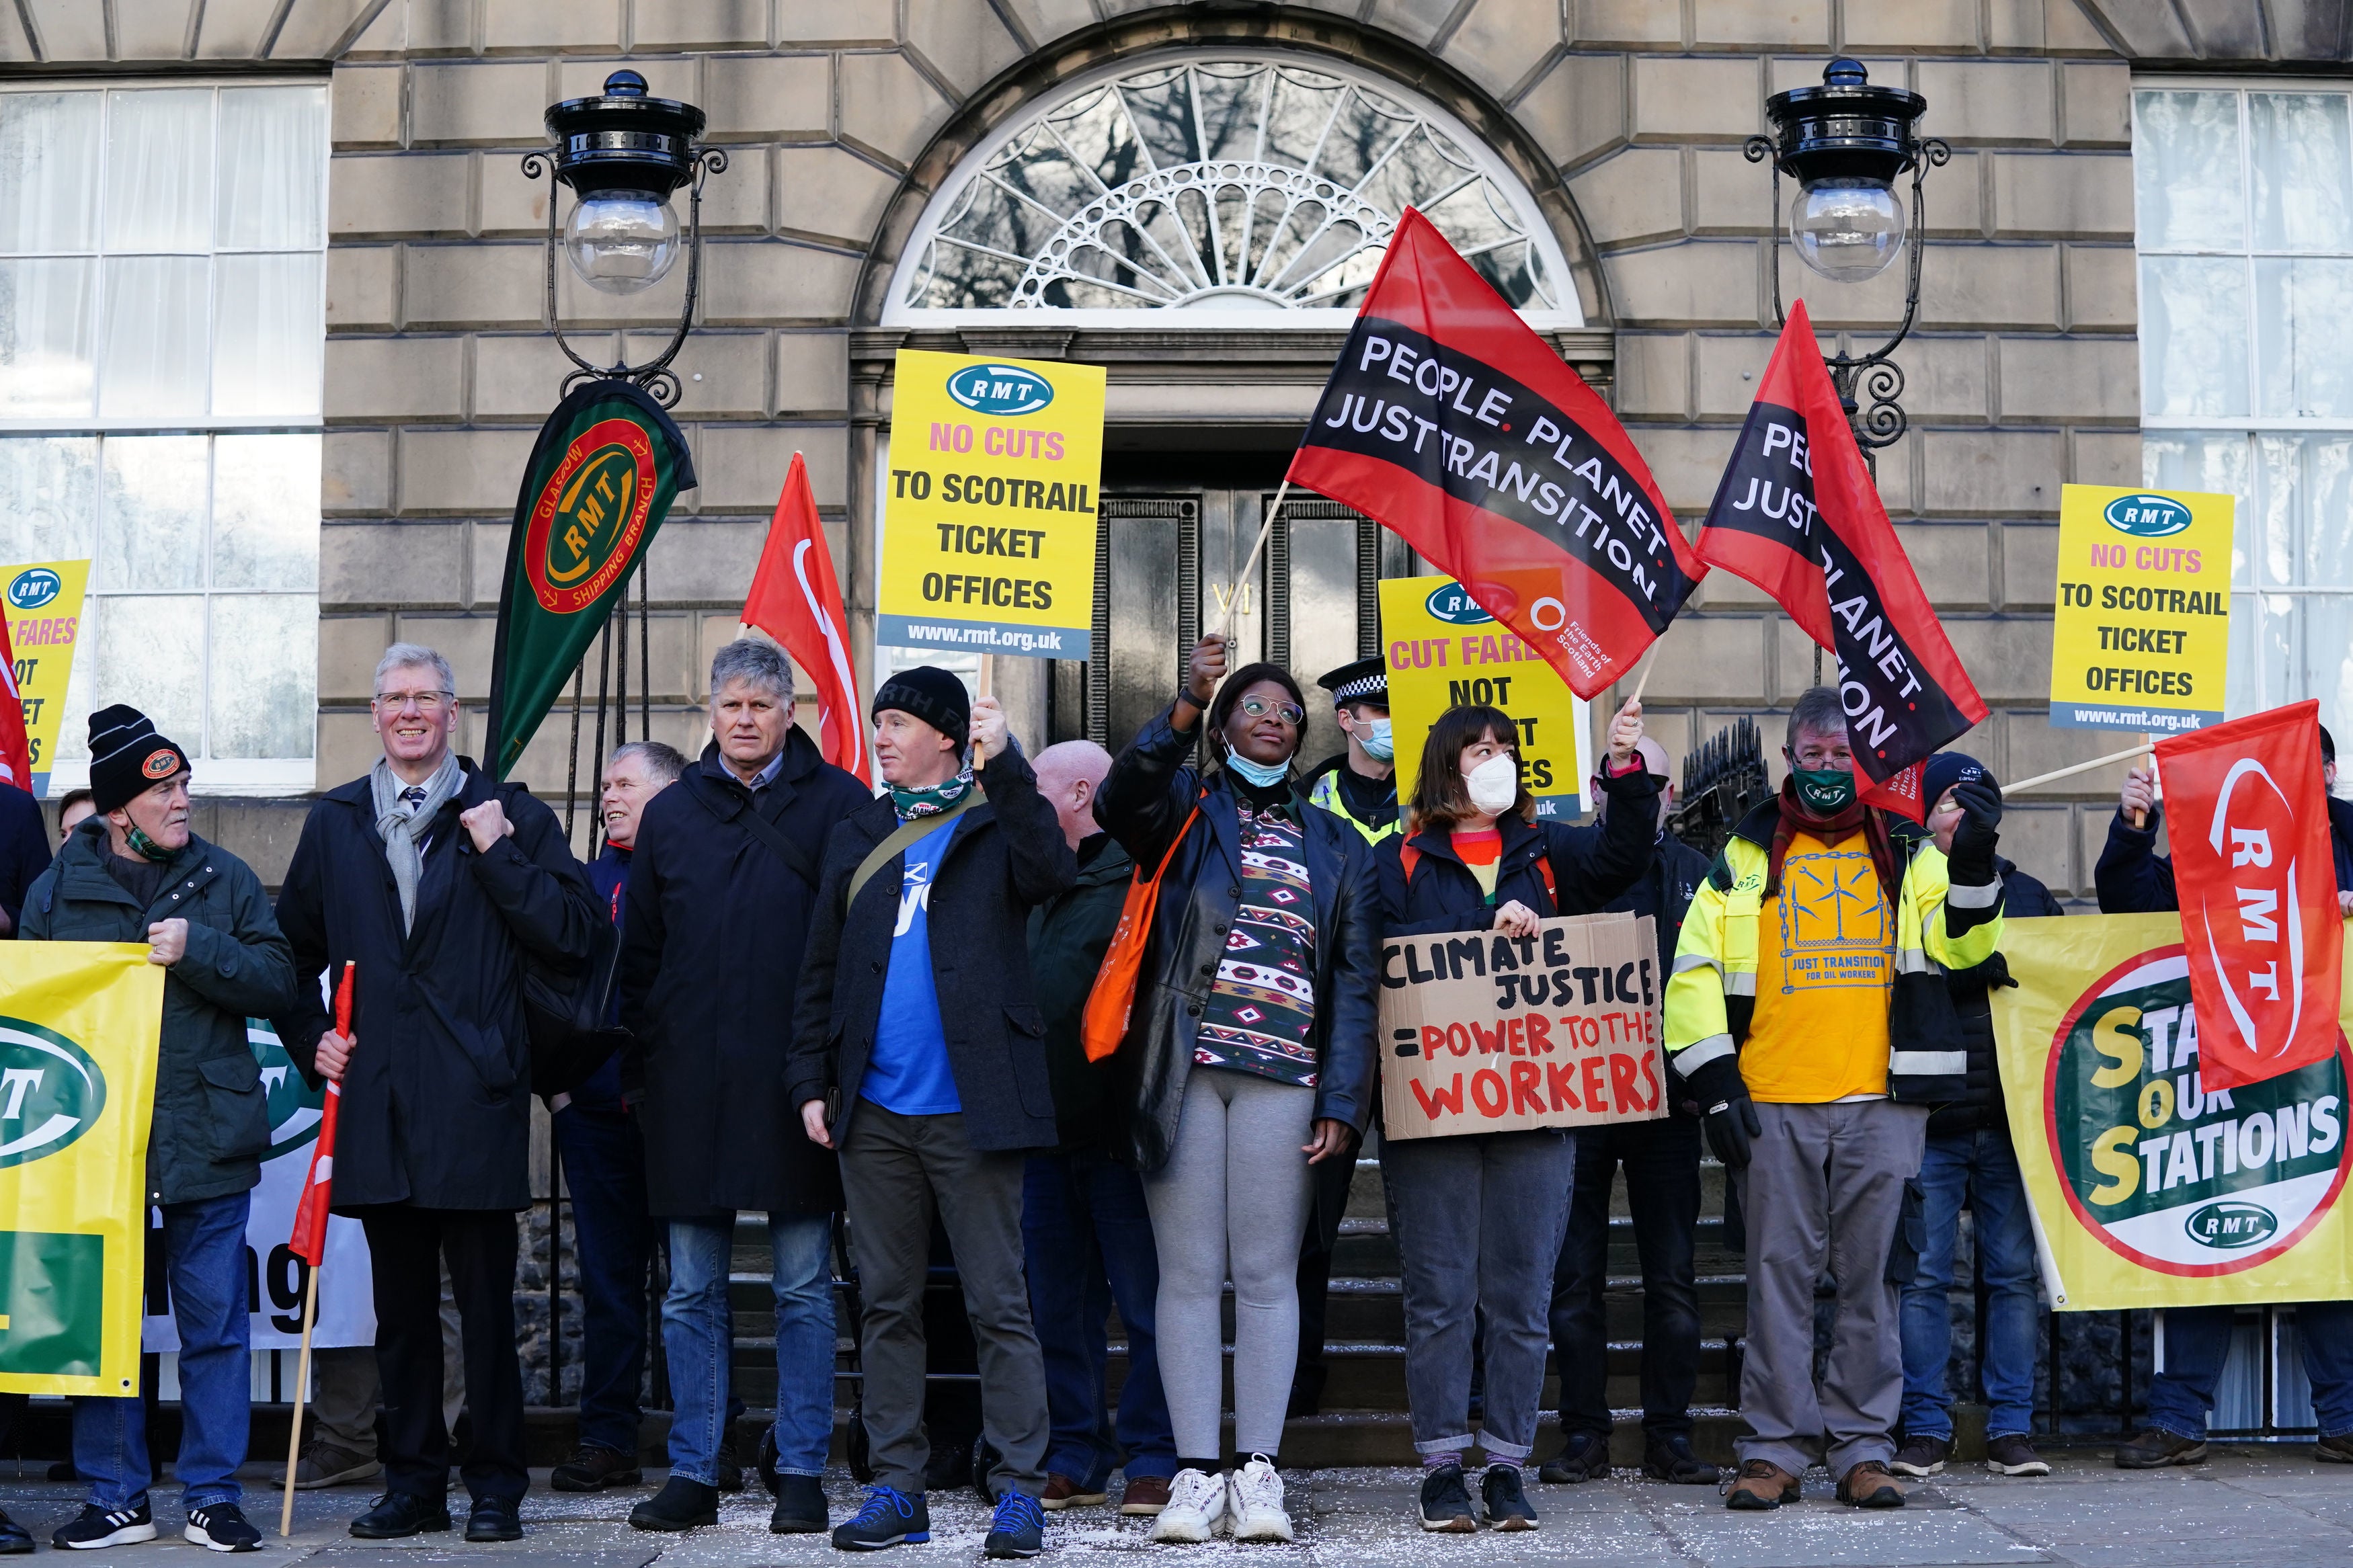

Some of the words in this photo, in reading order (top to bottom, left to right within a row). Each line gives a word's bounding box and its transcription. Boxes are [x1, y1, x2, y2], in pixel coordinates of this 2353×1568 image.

[971, 380, 1033, 401] RMT
[1325, 393, 1438, 454] JUST
[930, 422, 973, 454] NO
[984, 427, 1065, 460] CUTS
[539, 444, 582, 519] GLASGOW
[892, 469, 931, 499] TO
[942, 473, 1095, 513] SCOTRAIL
[563, 469, 616, 561] RMT
[1733, 477, 1817, 536] JUST
[2123, 507, 2176, 525] RMT
[573, 550, 625, 606] SHIPPING
[625, 477, 652, 548] BRANCH
[937, 523, 1046, 559] TICKET
[2090, 544, 2126, 568] NO
[2135, 546, 2202, 573] CUTS
[19, 580, 52, 597] RMT
[922, 572, 1053, 610] OFFICES
[1211, 583, 1250, 614] VI
[2061, 583, 2093, 608] TO
[2102, 585, 2227, 616] SCOTRAIL
[15, 616, 77, 647] FARES
[908, 624, 1062, 652] www.rmt.org.uk
[1570, 621, 1601, 655] Friends
[1601, 654, 1612, 664] of
[2098, 626, 2188, 655] TICKET
[1390, 638, 1450, 670] CUT
[1557, 634, 1595, 679] Scotland
[1564, 628, 1579, 644] the
[1579, 643, 1601, 671] Earth
[15, 659, 38, 685] OT
[2086, 666, 2193, 696] OFFICES
[1449, 676, 1511, 706] NOT
[2075, 709, 2201, 731] www.rmt.org.uk
[155, 757, 170, 770] RMT
[1813, 787, 1840, 800] RMT
[2231, 827, 2281, 1001] RMT
[1380, 927, 1570, 989] CLIMATE
[1793, 957, 1819, 971] JUST
[1495, 958, 1654, 1009] JUSTICE
[1806, 972, 1821, 981] FOR
[1824, 971, 1837, 979] OIL
[1839, 971, 1876, 979] WORKERS
[1421, 1013, 1555, 1061] POWER
[1560, 1015, 1600, 1050] TO
[1601, 1011, 1655, 1045] THE
[2091, 1001, 2200, 1089] STA
[1409, 1049, 1660, 1121] WORKERS
[2089, 1096, 2340, 1206] STATIONS
[2205, 1215, 2261, 1235] RMT
